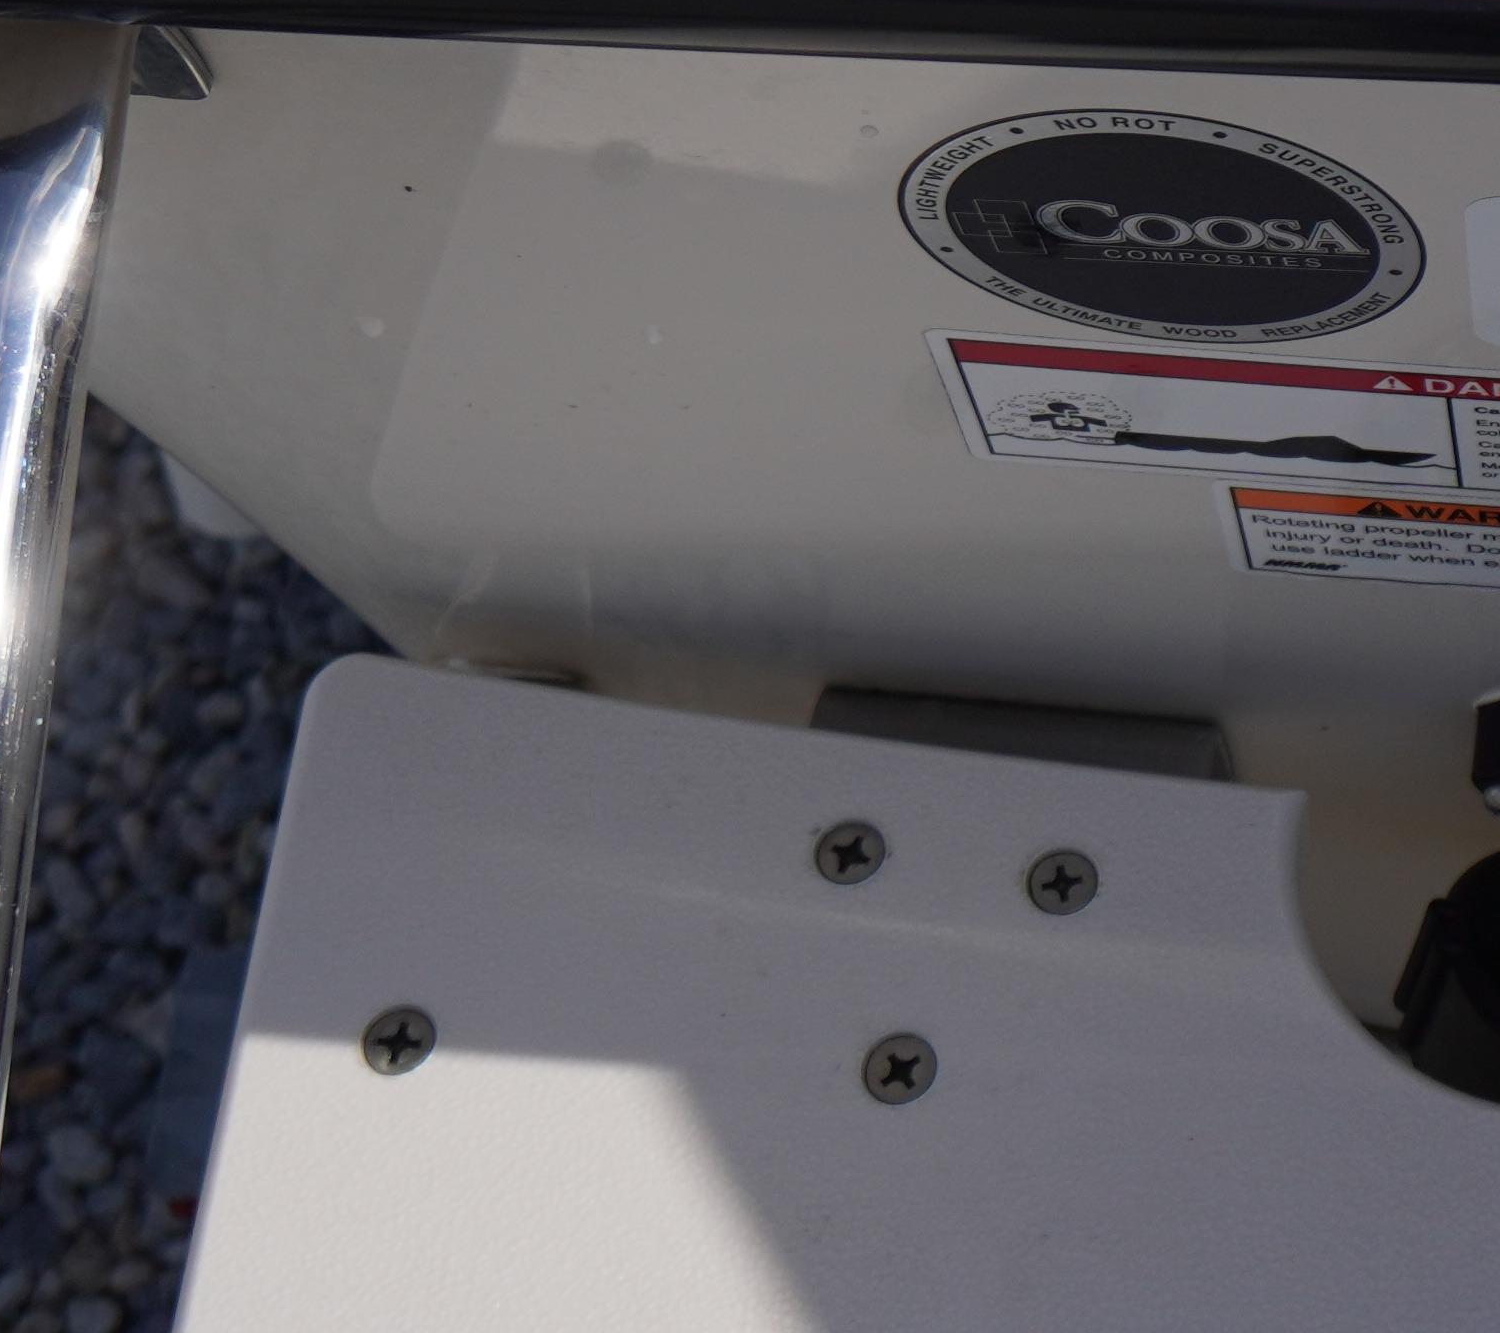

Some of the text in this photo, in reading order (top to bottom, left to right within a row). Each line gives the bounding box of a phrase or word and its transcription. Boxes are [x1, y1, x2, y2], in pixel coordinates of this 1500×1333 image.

[1054, 116, 1177, 132] NO ROT
[915, 136, 993, 220] LIGHTWEIGHT
[1258, 142, 1404, 245] SUPERSTRONG
[1036, 199, 1370, 255] COOSA
[1104, 247, 1322, 268] COMPOSITES
[985, 276, 1390, 340] THE ULTIMATE WOOD REPLACEMENT
[1252, 514, 1355, 533] Rotating
[1364, 523, 1471, 541] propeller
[1266, 529, 1331, 544] injury
[1340, 535, 1365, 544] or
[1372, 537, 1449, 551] death.
[1272, 544, 1315, 555] use
[1324, 546, 1400, 561] ladder
[1409, 553, 1475, 567] when
